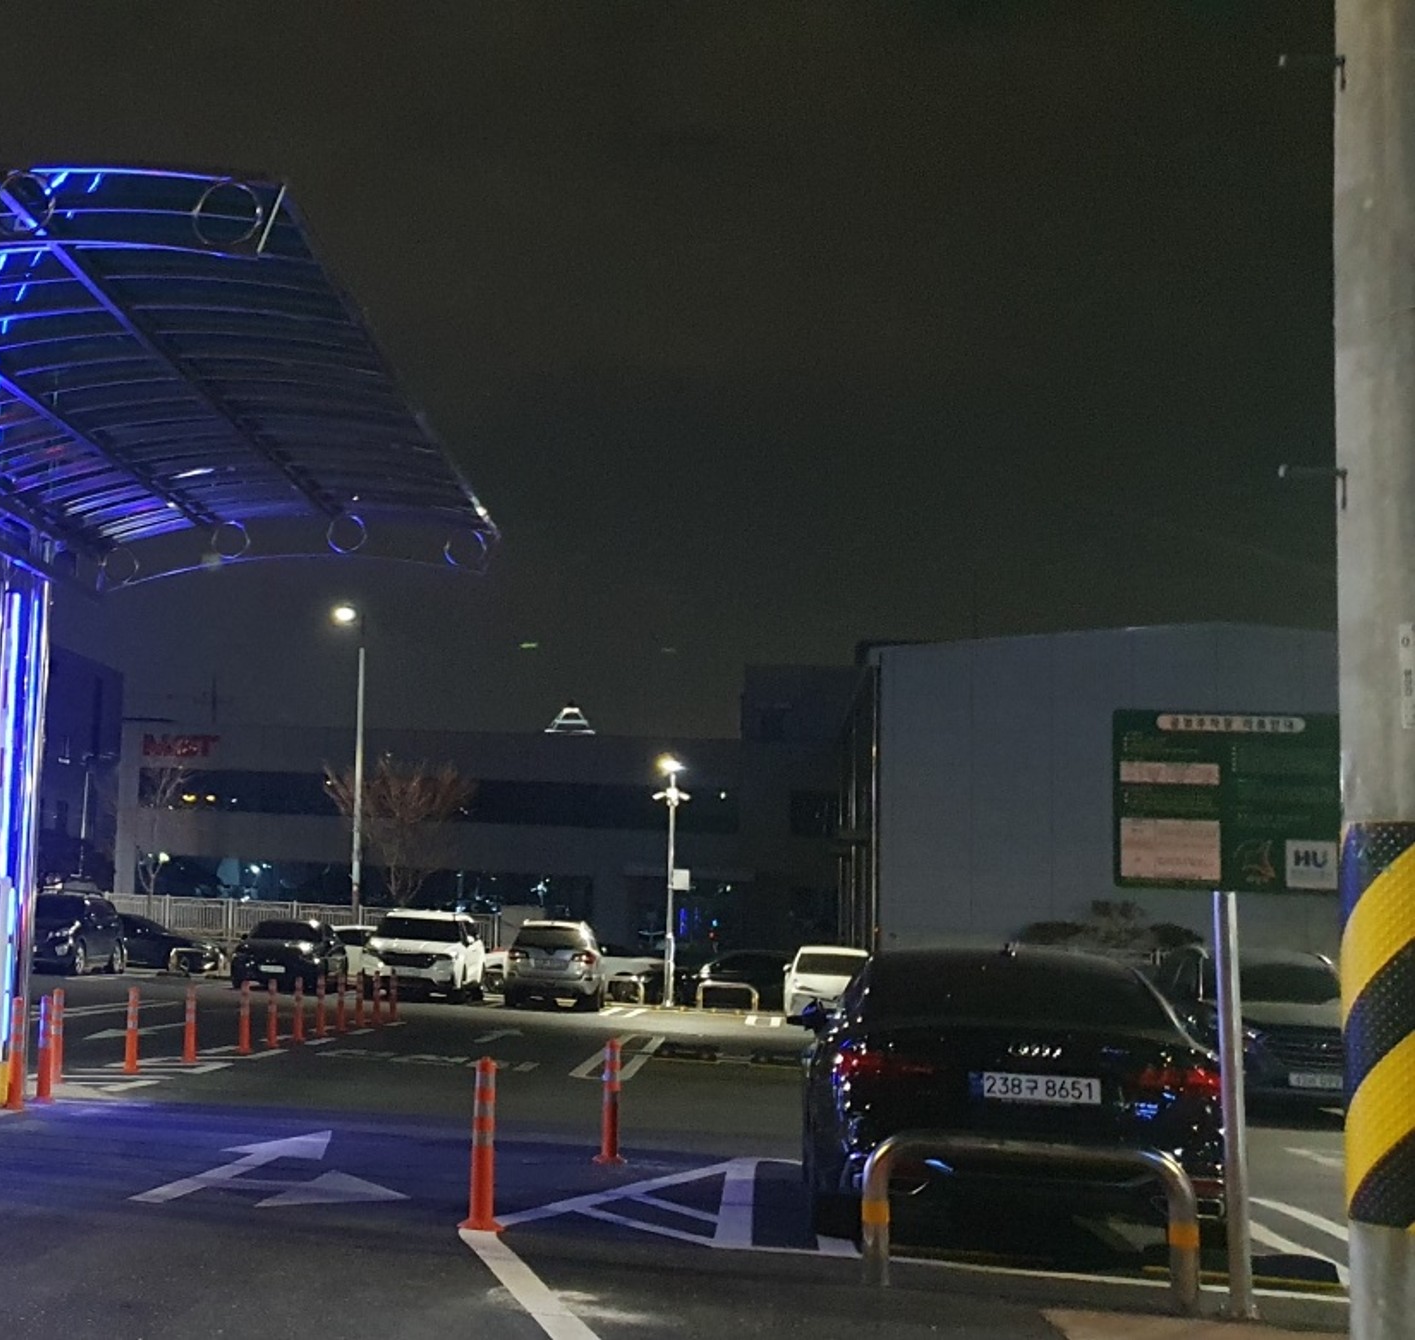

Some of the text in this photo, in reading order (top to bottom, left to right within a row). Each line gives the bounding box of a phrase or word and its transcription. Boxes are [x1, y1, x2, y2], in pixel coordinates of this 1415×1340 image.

[1293, 849, 1328, 869] HU
[985, 1074, 1093, 1101] 238구 8651
